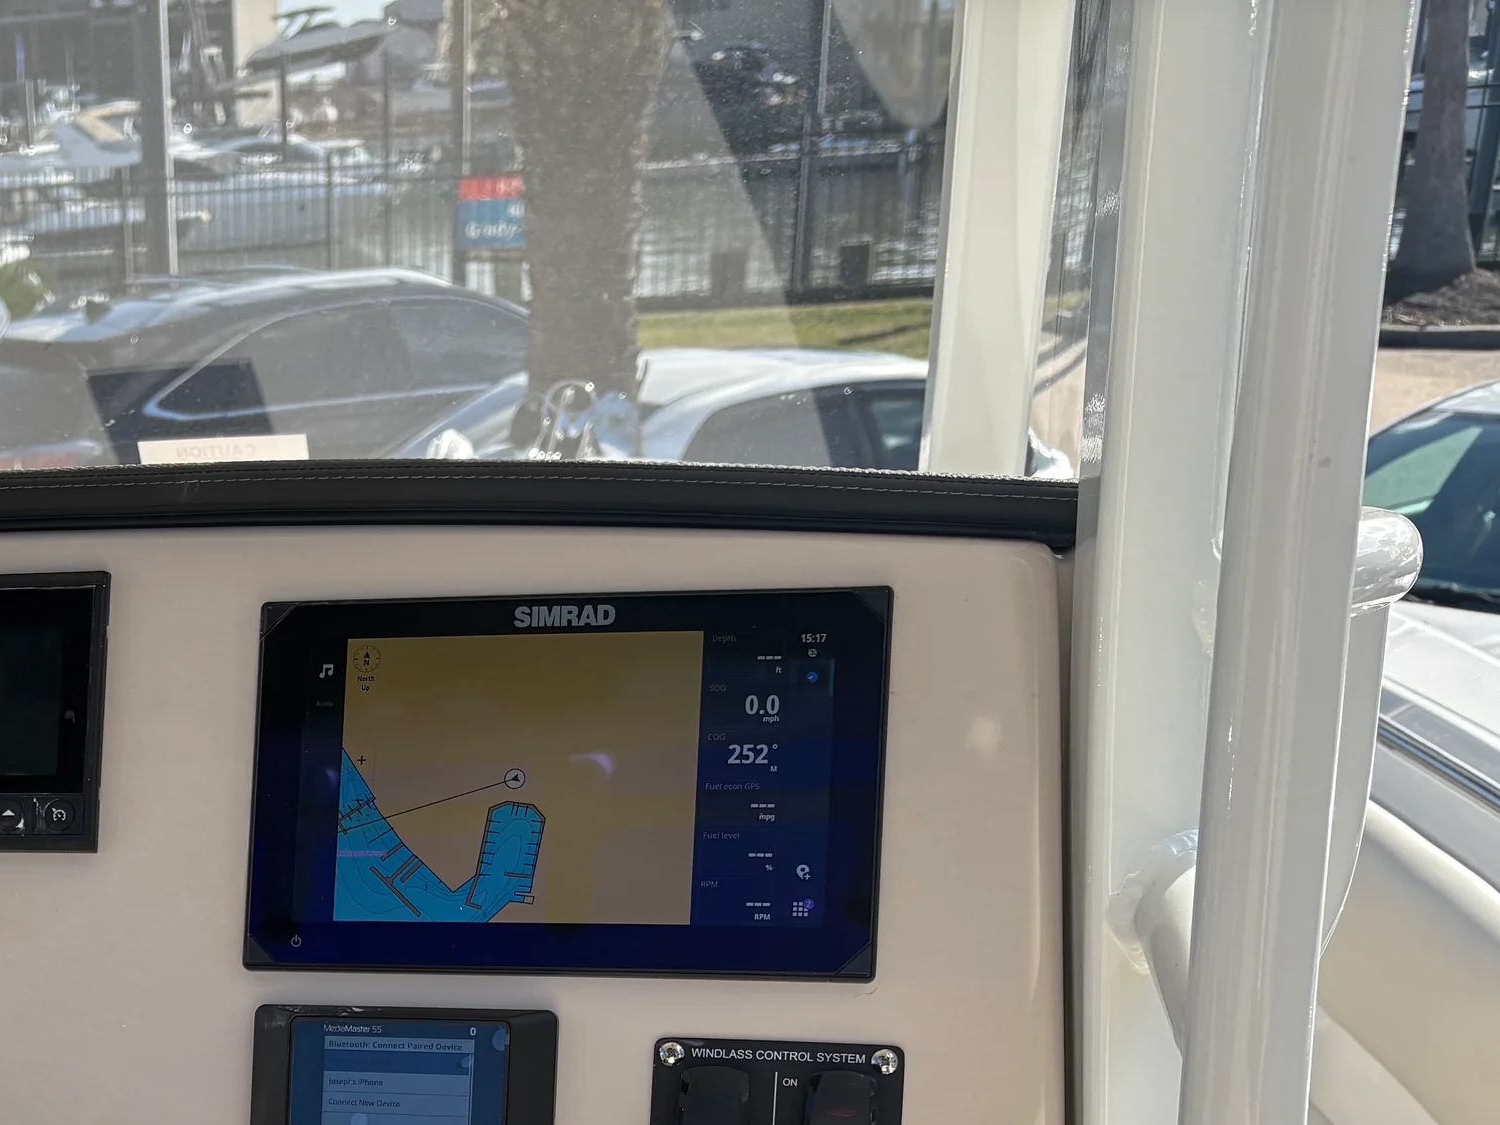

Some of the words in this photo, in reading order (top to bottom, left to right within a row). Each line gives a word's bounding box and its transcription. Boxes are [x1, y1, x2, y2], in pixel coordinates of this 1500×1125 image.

[513, 604, 616, 628] SIMRAD
[712, 635, 736, 643] Depth
[801, 633, 827, 643] 15:17
[709, 684, 727, 692] SOG
[745, 694, 780, 715] 0.0
[763, 715, 780, 723] mph
[707, 733, 726, 741] COG
[705, 783, 722, 791] Fuel
[723, 784, 743, 792] econ
[744, 782, 760, 790] GPS
[703, 832, 720, 840] Fuel
[721, 832, 740, 840] level
[700, 880, 719, 888] RPM
[754, 913, 771, 921] RPM
[329, 1040, 370, 1048] Bluetooth:
[372, 1041, 405, 1050] Connect
[407, 1042, 434, 1050] Paired
[435, 1043, 463, 1051] Device
[691, 1047, 753, 1060] WINDLASS
[755, 1050, 814, 1062] CONTROL
[816, 1052, 866, 1064] SYSTEM
[782, 1077, 798, 1087] ON
[328, 1098, 357, 1106] Connect
[358, 1099, 375, 1107] New
[376, 1100, 400, 1108] Device
